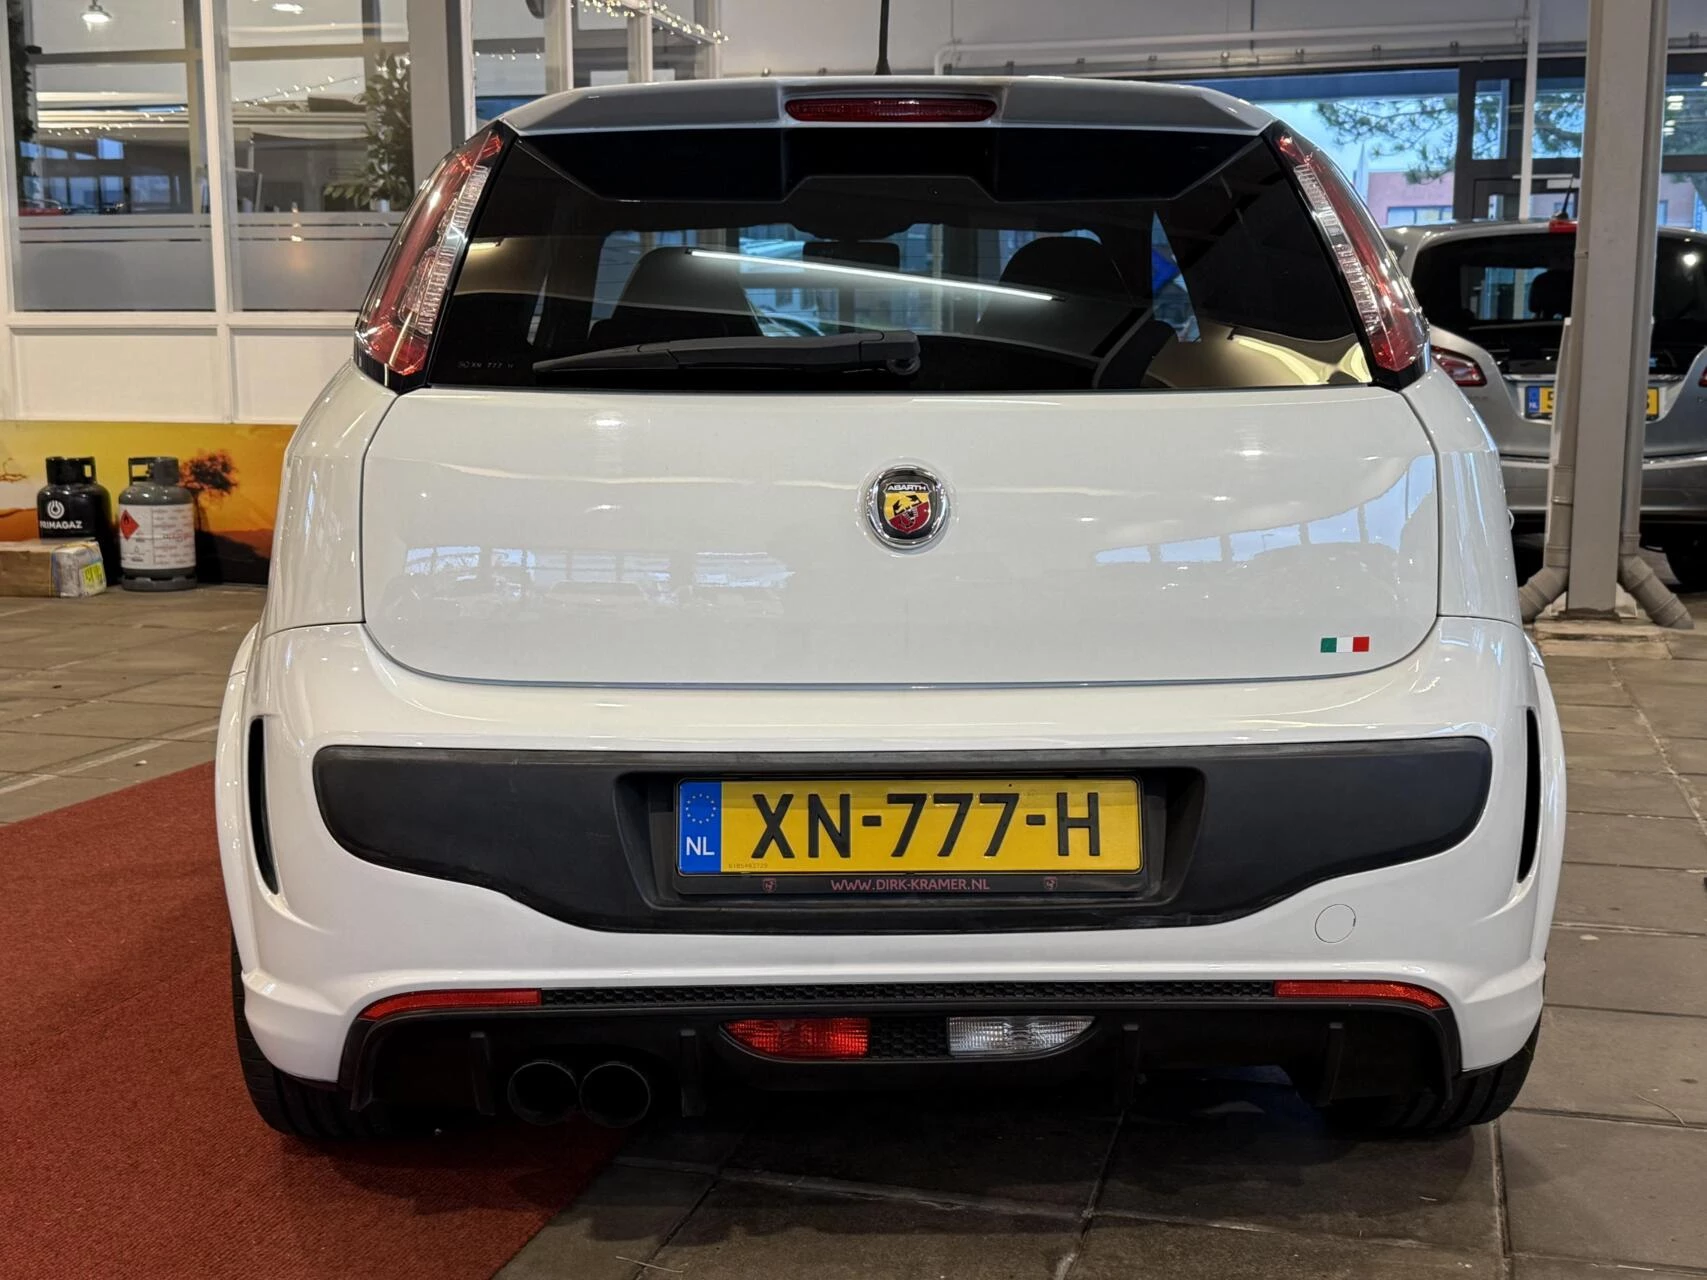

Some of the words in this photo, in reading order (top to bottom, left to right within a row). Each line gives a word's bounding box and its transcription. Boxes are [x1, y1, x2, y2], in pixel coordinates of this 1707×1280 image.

[751, 792, 1100, 858] XN-777-H
[686, 836, 715, 856] NL
[830, 878, 990, 891] WWW.DIRK-KRAMER.NL
